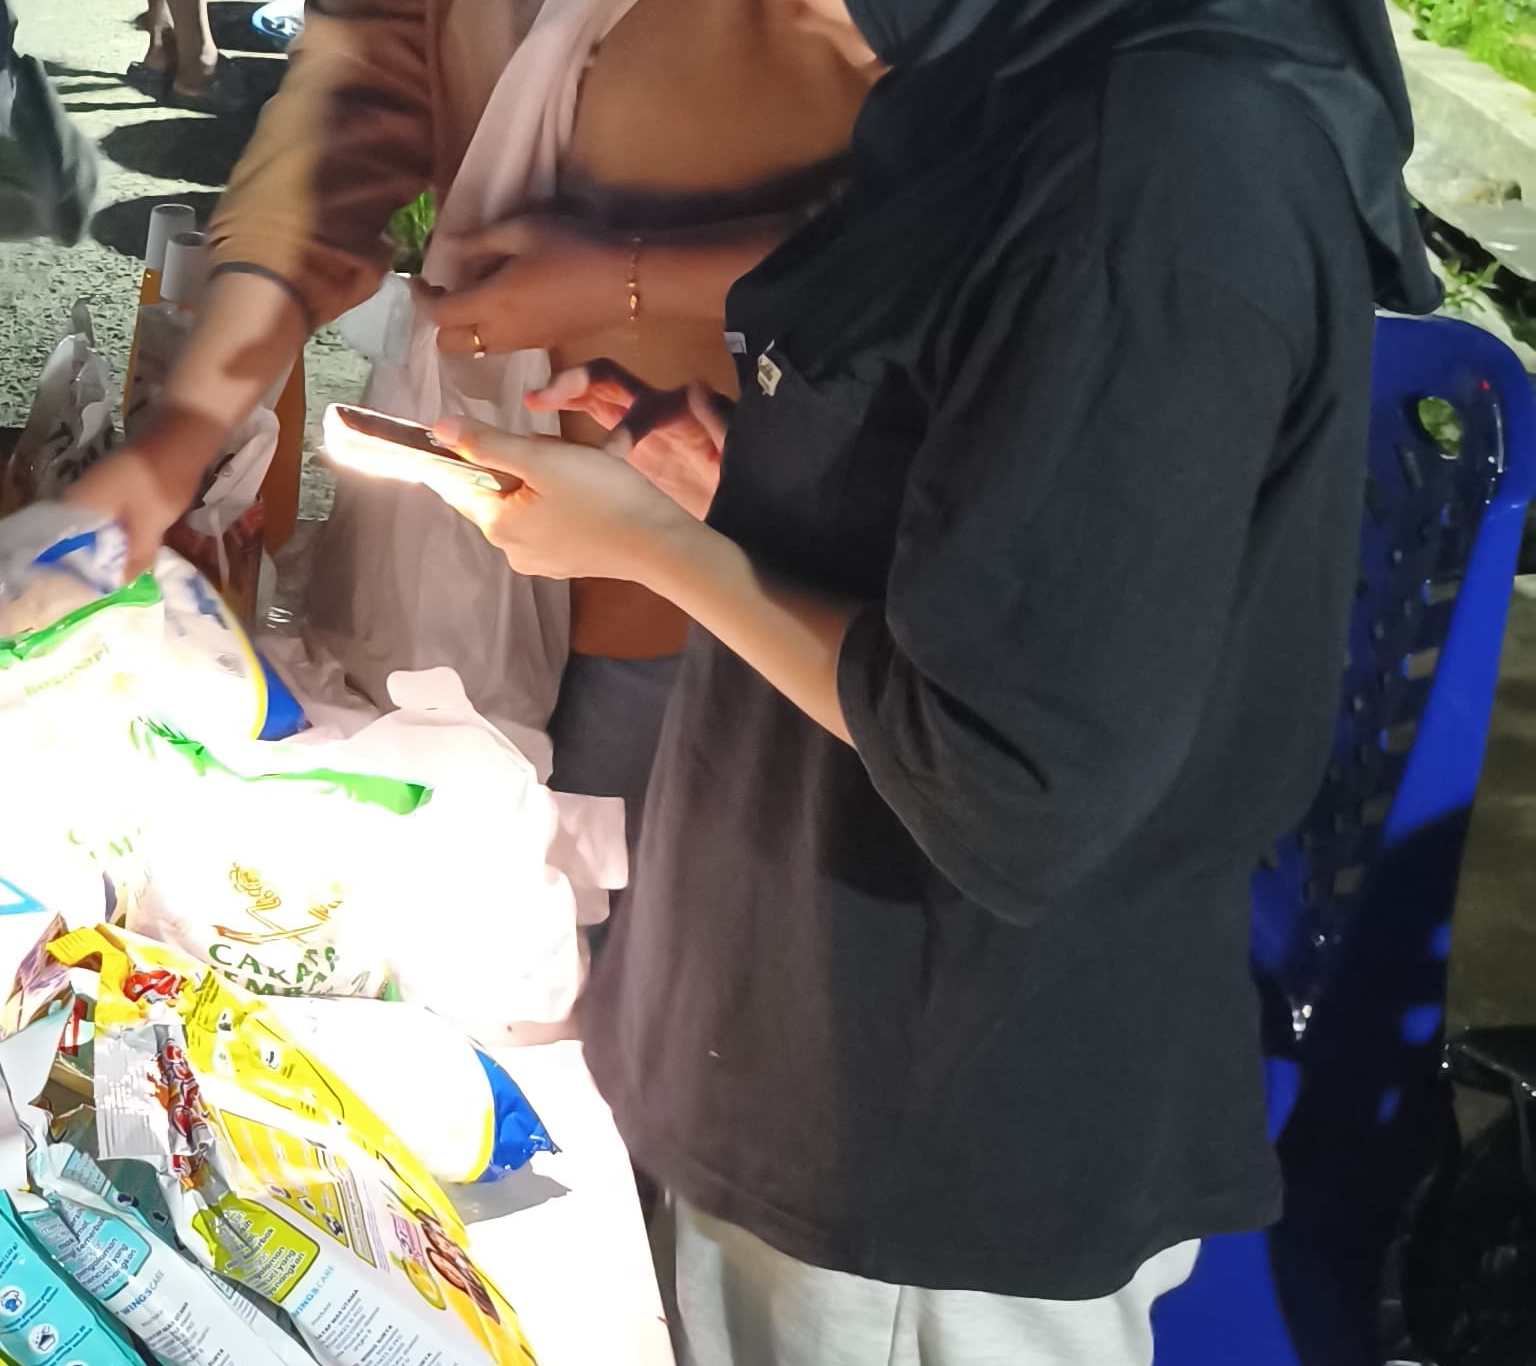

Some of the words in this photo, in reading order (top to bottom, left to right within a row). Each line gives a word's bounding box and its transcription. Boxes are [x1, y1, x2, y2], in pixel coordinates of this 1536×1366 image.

[109, 1243, 130, 1264] yang
[275, 1248, 297, 1272] yang
[119, 1287, 154, 1317] WINGS
